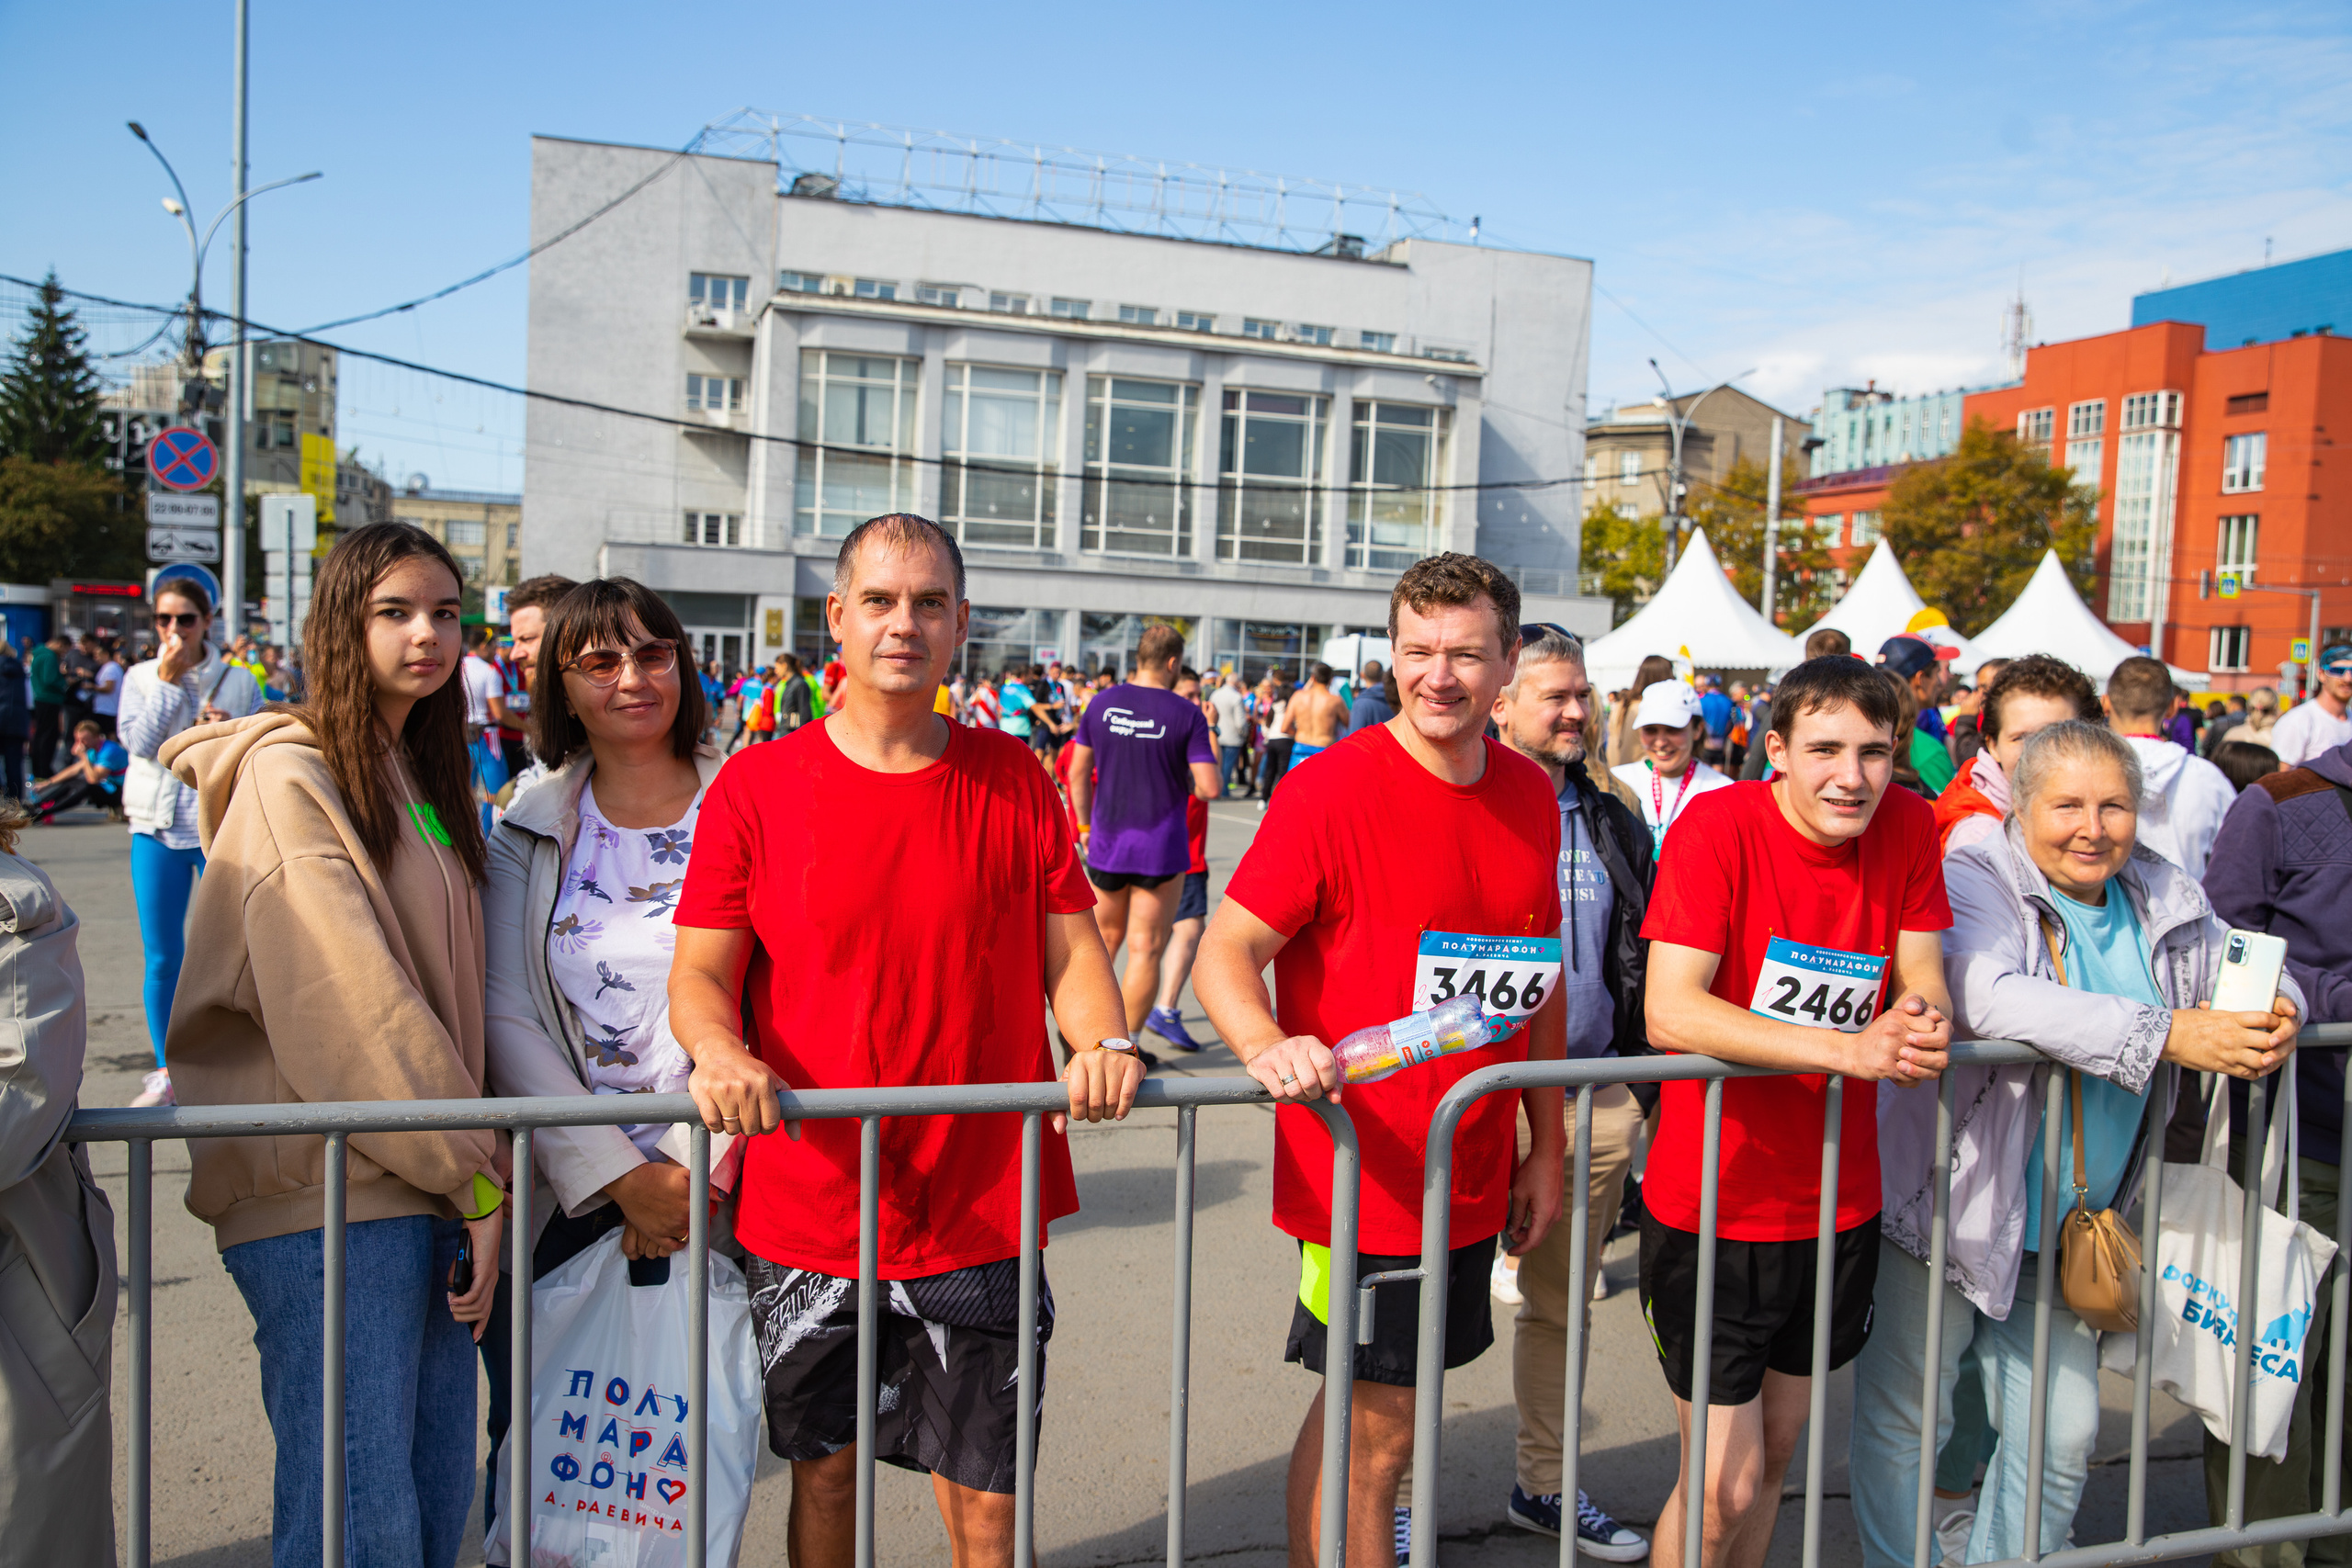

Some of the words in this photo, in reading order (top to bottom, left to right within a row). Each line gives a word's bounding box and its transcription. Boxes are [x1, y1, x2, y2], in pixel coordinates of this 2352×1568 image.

[1442, 942, 1536, 954] ПОЛУМАРАФОН
[1790, 951, 1880, 974] ПОЛУМАРАФОН
[1430, 967, 1544, 1010] 3466
[1768, 976, 1877, 1026] 2466
[2163, 1265, 2256, 1338] ФОРМУЛ
[562, 1369, 688, 1423] ПОЛУ
[559, 1410, 688, 1472] МАРА
[549, 1452, 648, 1501] ФОН
[545, 1491, 566, 1508] А.
[576, 1499, 683, 1531] РАЕВИЧА
